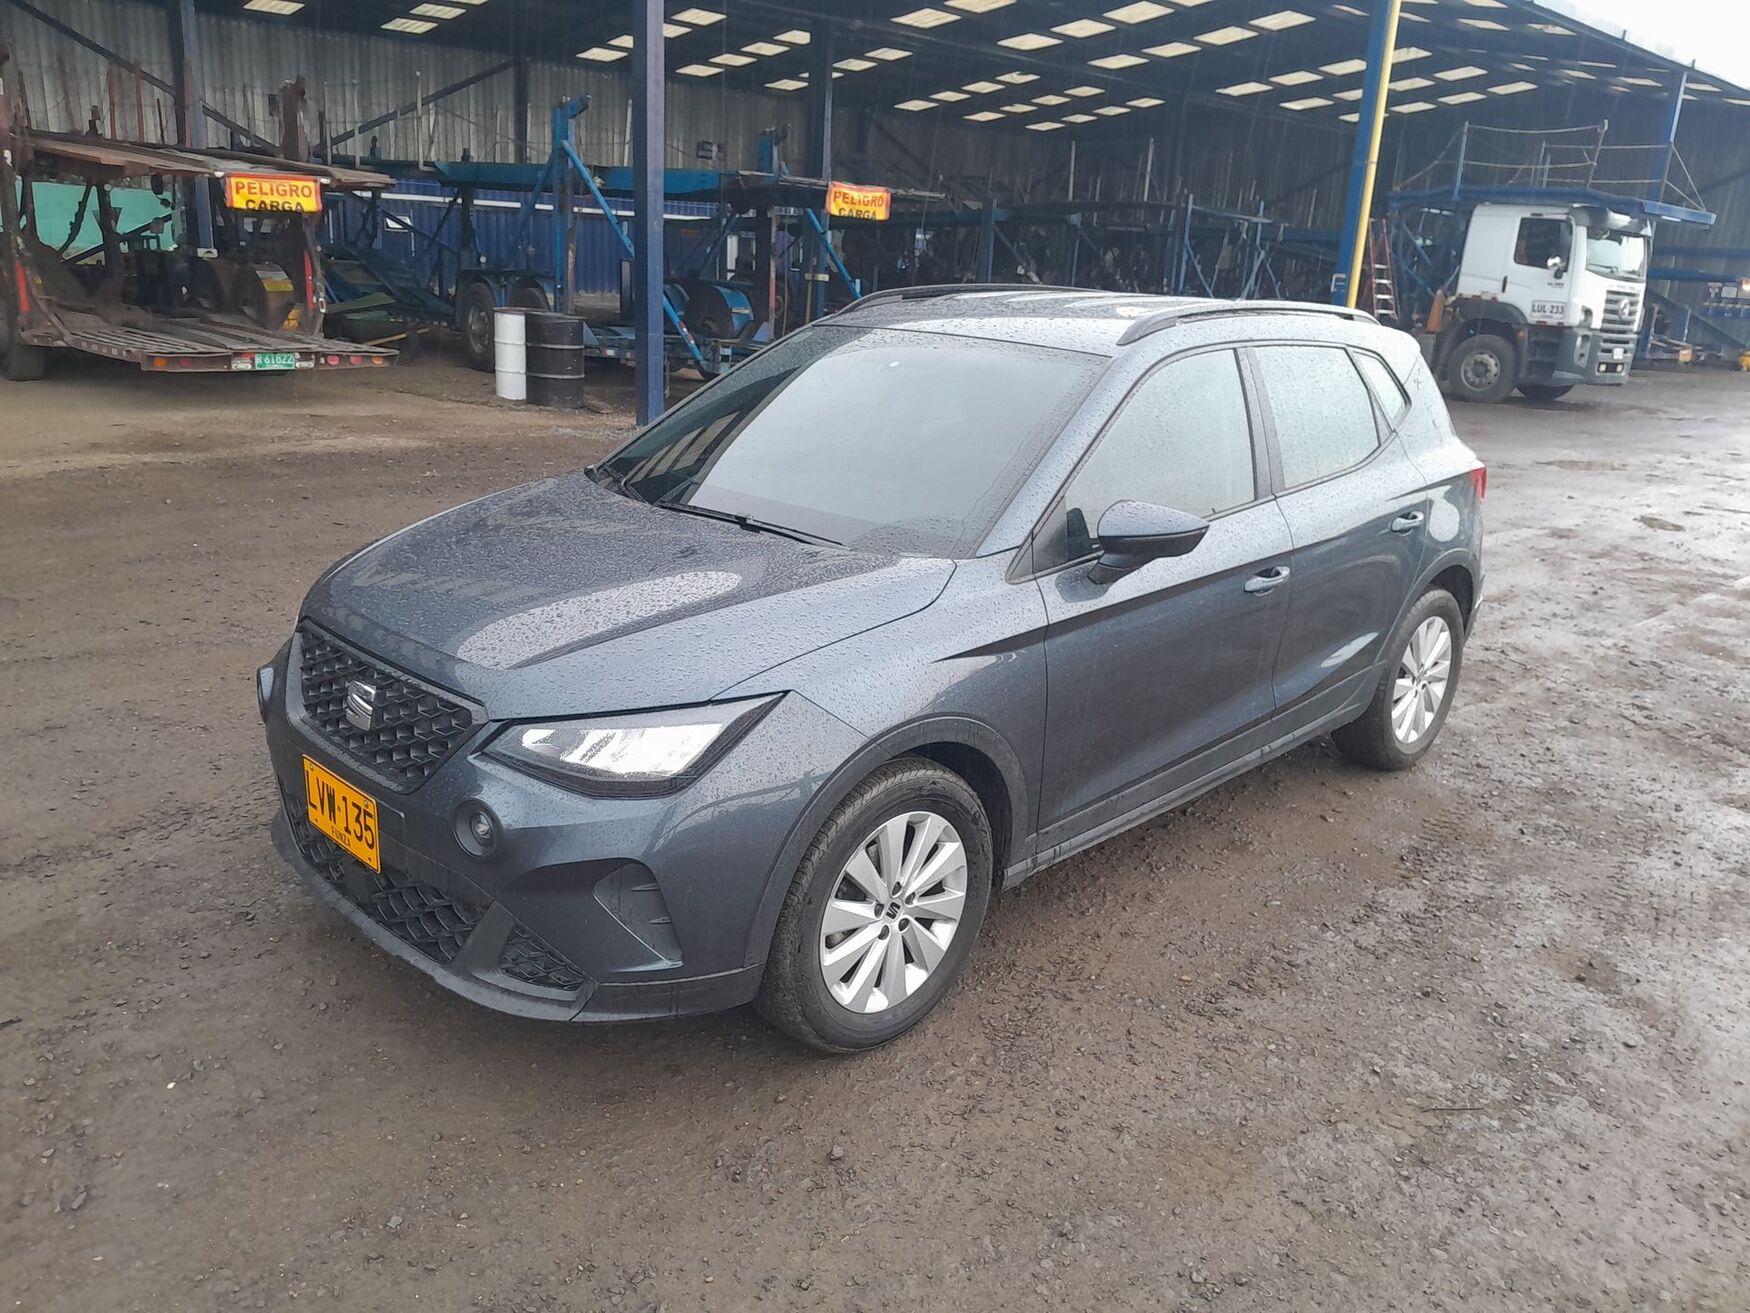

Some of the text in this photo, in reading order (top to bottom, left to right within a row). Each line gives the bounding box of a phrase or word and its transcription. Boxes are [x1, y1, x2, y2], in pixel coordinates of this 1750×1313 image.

[235, 181, 312, 198] PELIGRO
[245, 199, 304, 212] CARGA
[833, 191, 884, 207] PELIGRO
[838, 207, 878, 220] CARGA
